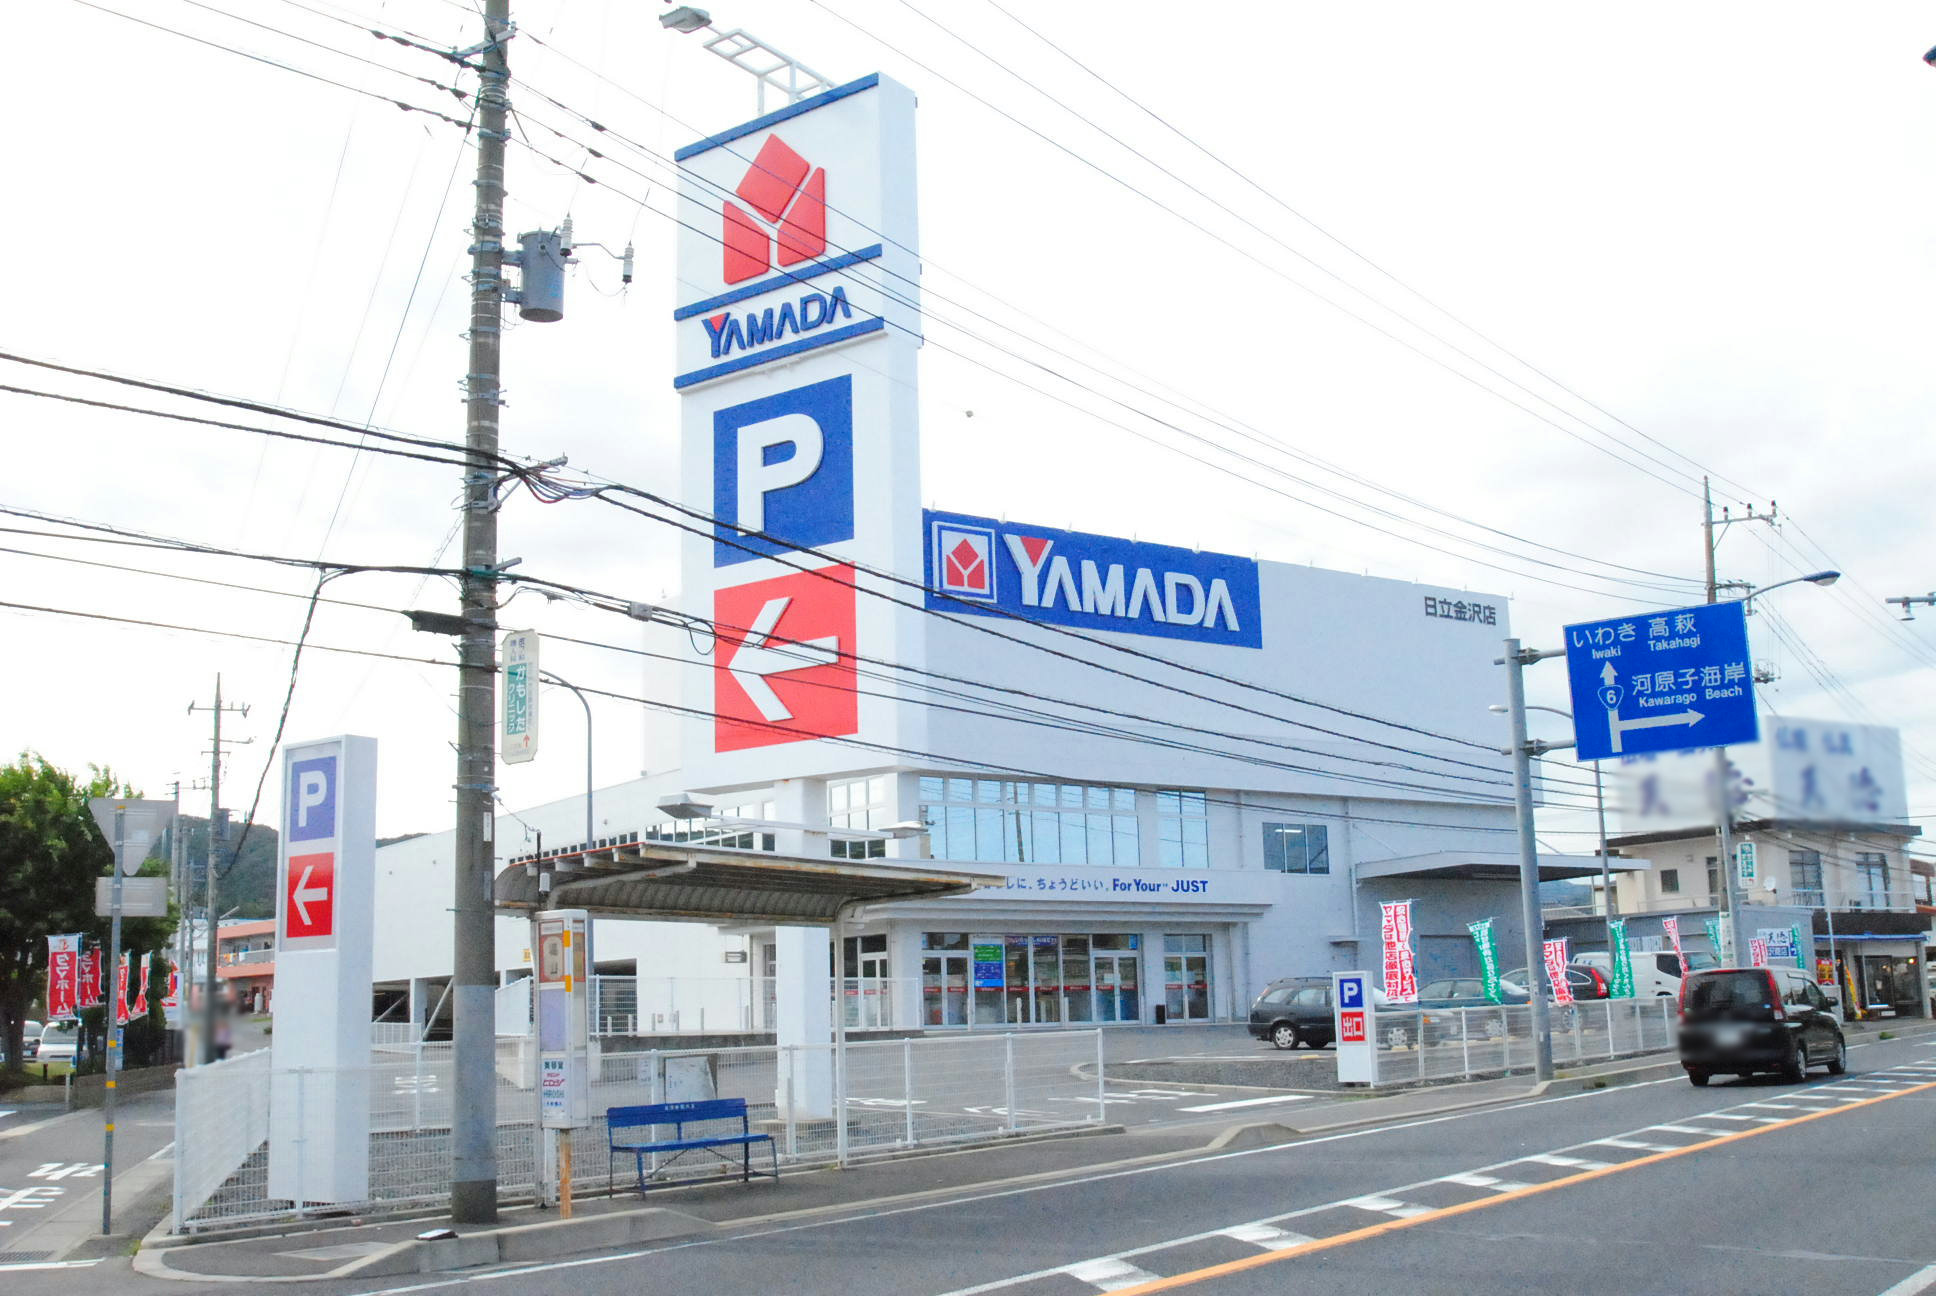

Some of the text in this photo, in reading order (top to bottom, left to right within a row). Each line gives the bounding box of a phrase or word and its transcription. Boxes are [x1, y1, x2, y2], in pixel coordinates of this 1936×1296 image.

[701, 286, 852, 358] YAMADA
[737, 413, 824, 537] P
[1002, 533, 1240, 632] YAMADA
[1424, 595, 1497, 626] 日立金沢店
[1573, 614, 1697, 648] いわき 高萩
[1592, 634, 1701, 659] Iwaki Takahagi
[1632, 662, 1746, 695] 河原子海岸
[1606, 690, 1617, 704] 6
[1639, 685, 1742, 707] Kawarago Beach
[298, 770, 328, 827] P
[1112, 878, 1131, 892] For
[1171, 879, 1208, 893] JUST
[1343, 982, 1358, 1003] P
[1343, 1017, 1362, 1036] 出口
